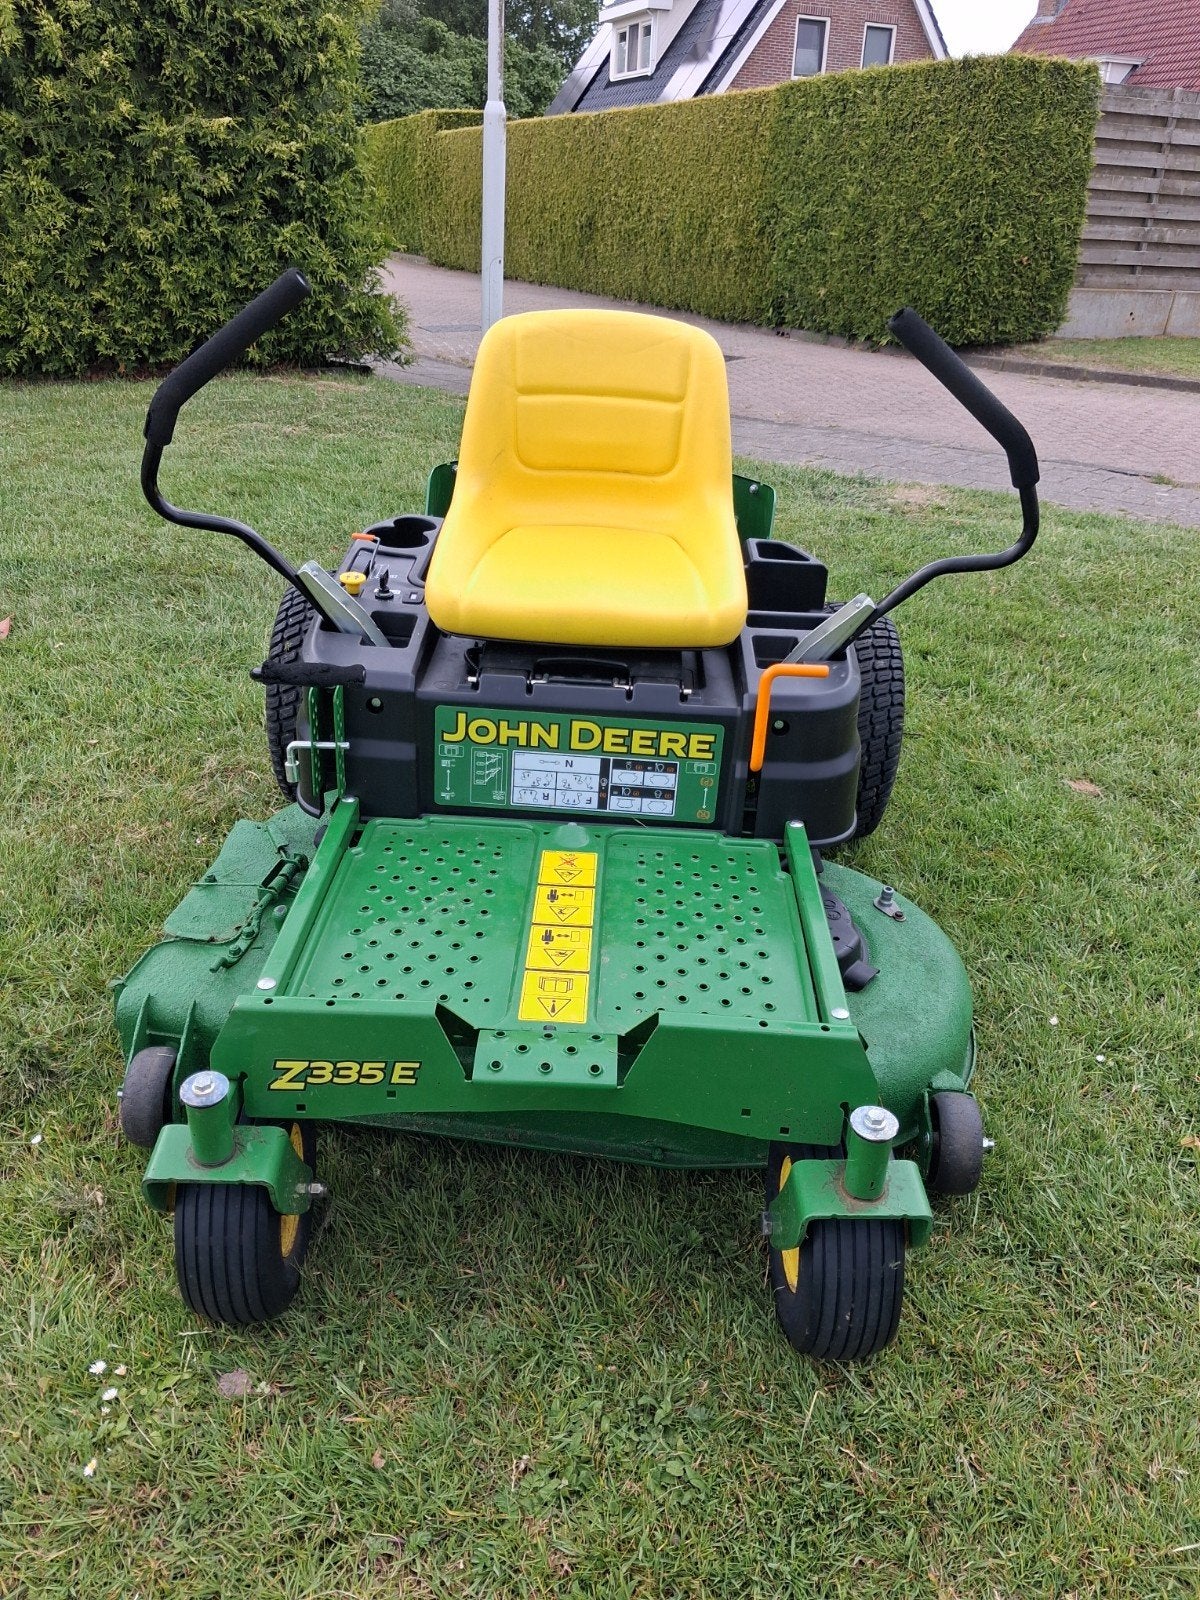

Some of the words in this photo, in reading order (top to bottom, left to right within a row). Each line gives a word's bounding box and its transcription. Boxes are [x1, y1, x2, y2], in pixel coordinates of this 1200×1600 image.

[442, 712, 559, 749] JOHN
[569, 719, 716, 759] DEERE
[565, 760, 574, 768] N
[542, 792, 550, 801] R
[585, 796, 592, 805] F
[268, 1059, 388, 1091] Z335
[389, 1061, 422, 1085] E
